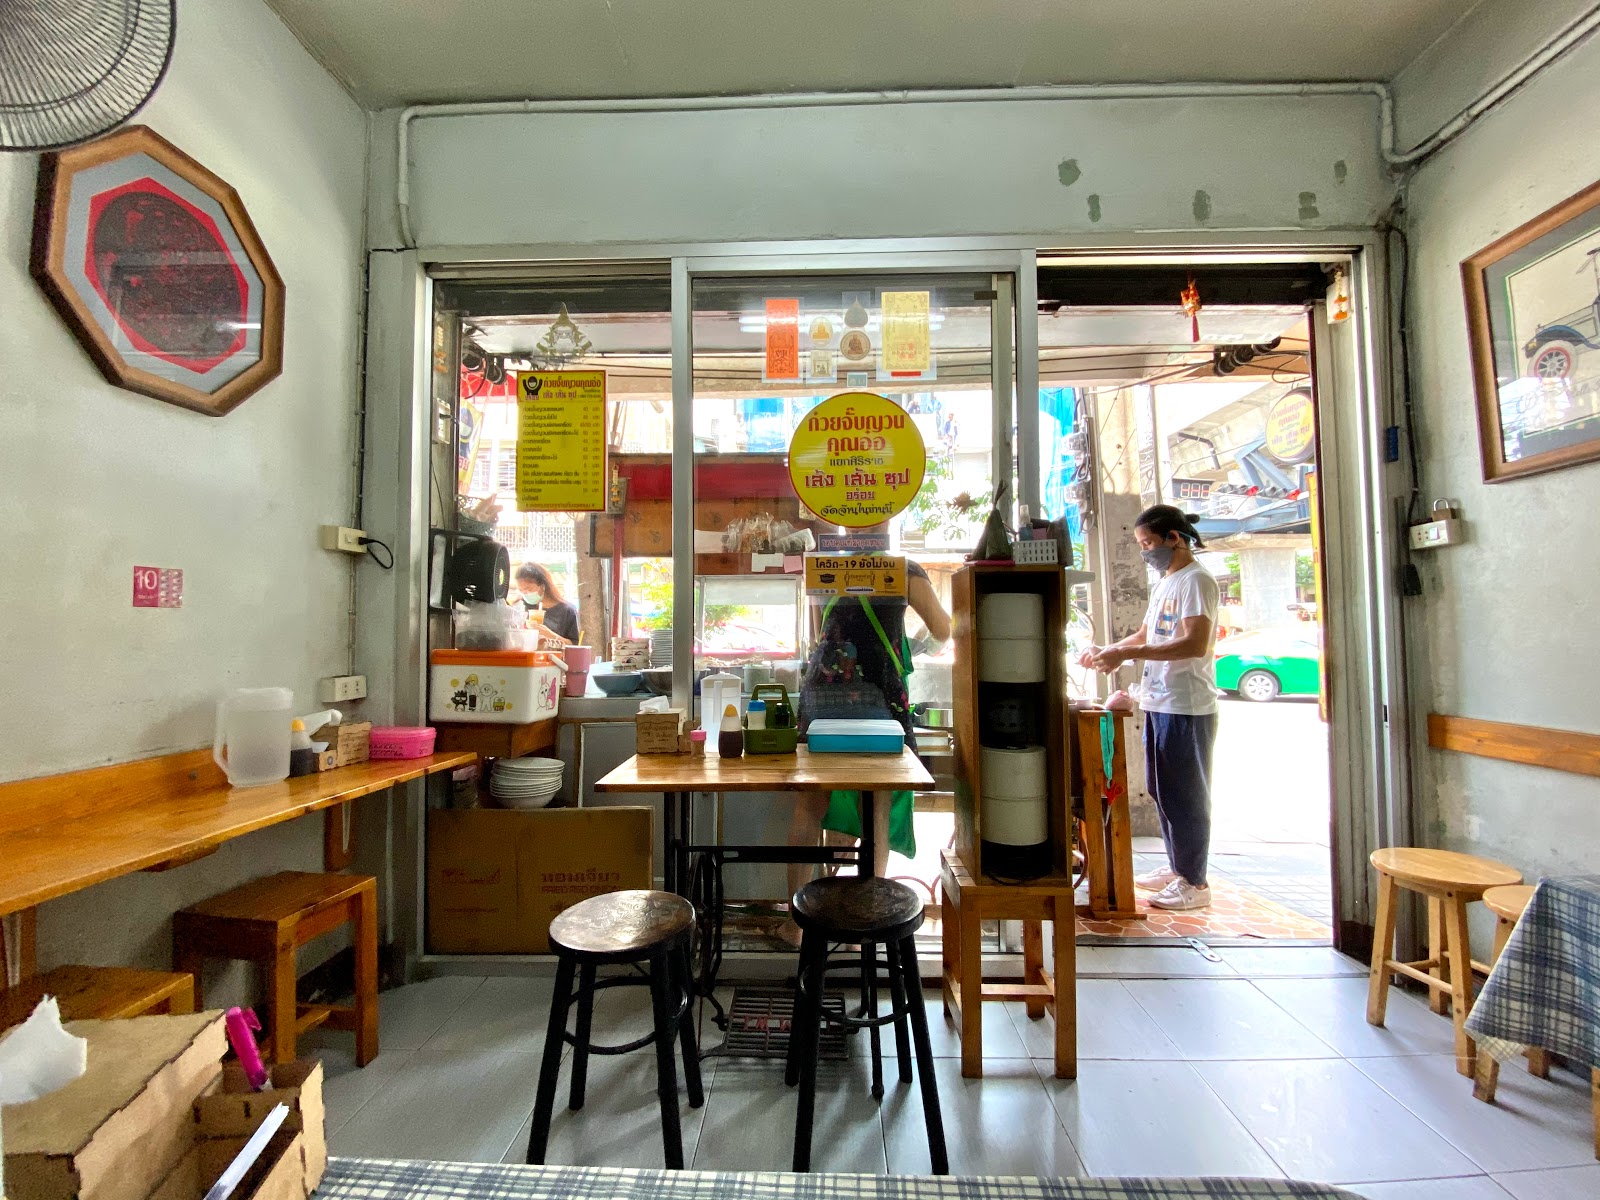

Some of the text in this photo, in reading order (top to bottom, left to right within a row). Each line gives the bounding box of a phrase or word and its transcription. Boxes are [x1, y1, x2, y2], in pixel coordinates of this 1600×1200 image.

[808, 407, 905, 432] ก๋วยจั๊บญวน
[827, 430, 886, 456] คุณอ๋อ
[829, 455, 884, 467] แยกศิริราช
[844, 467, 877, 487] เส้น
[884, 467, 911, 490] ซุป
[846, 487, 876, 501] อร่อย
[815, 557, 895, 569] โควิด-19 ยังไม่จบ
